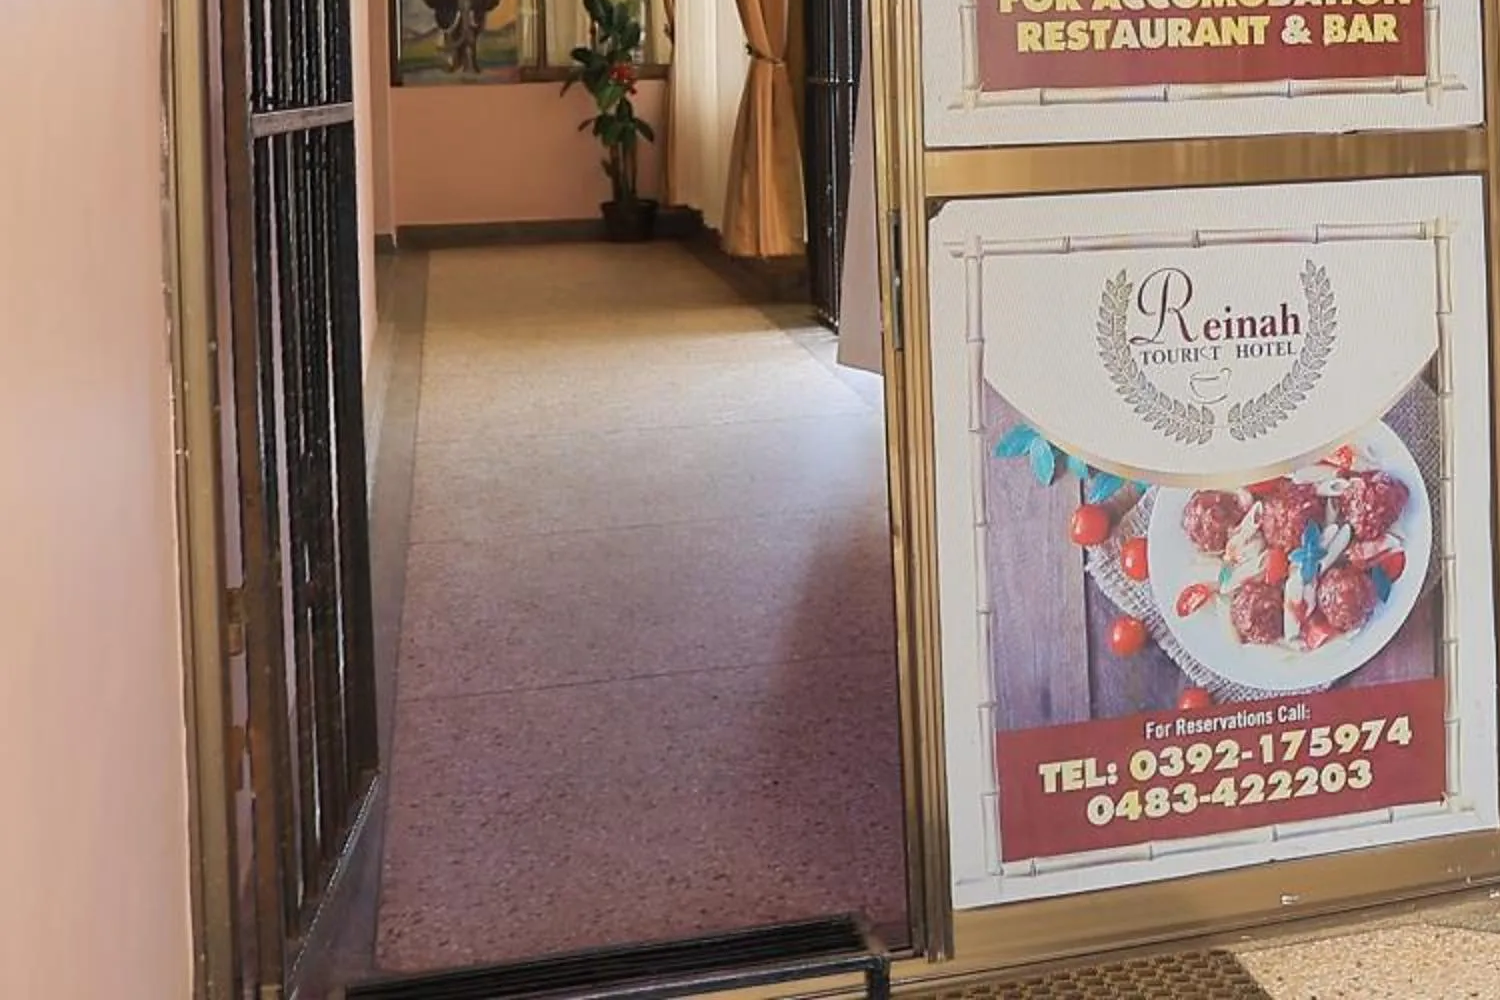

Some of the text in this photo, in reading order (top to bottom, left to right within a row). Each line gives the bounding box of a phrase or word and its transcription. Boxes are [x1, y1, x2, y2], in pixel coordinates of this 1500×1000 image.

[1017, 13, 1398, 52] RESTAURANT & BAR
[1129, 267, 1302, 344] Reinah
[1236, 341, 1297, 359] HOTEL
[1146, 705, 1311, 740] For Reservations Call:
[1038, 716, 1412, 794] TEL: 0392-175974
[1086, 759, 1373, 826] 0483-422203
